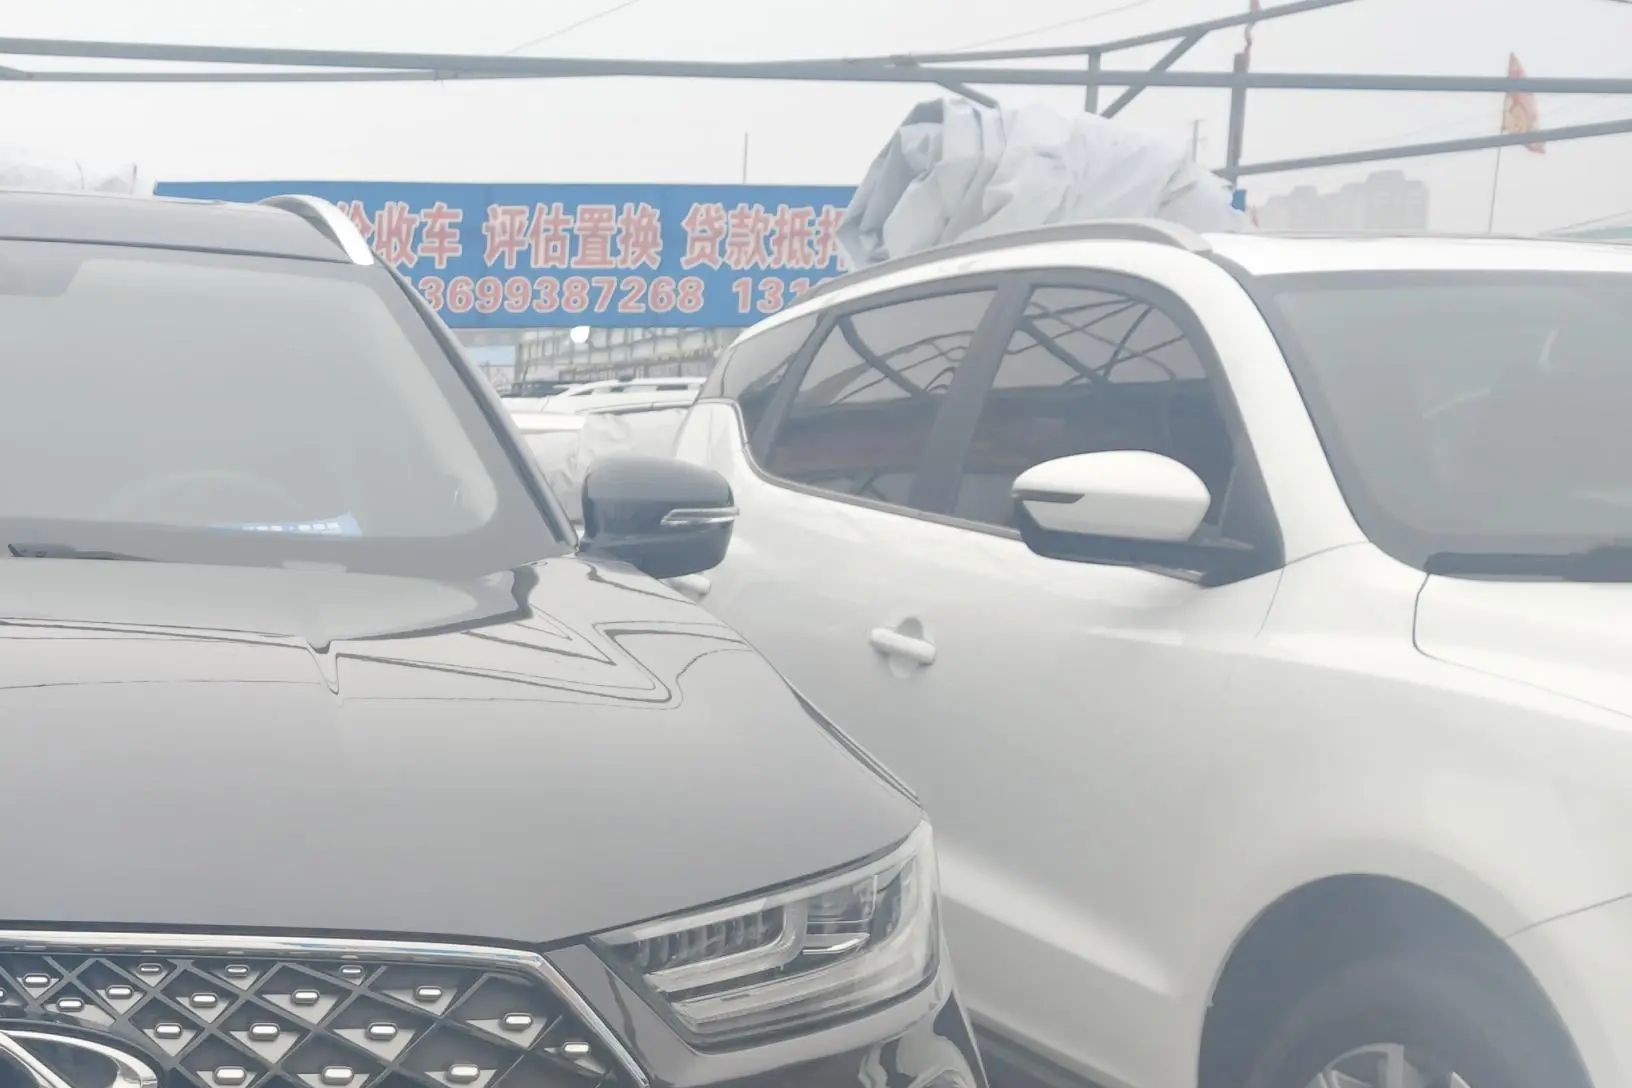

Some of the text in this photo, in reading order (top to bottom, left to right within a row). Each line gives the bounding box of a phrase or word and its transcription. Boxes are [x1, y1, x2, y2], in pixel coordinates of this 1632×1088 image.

[483, 203, 663, 269] 评估置换
[404, 276, 704, 313] 3699387268
